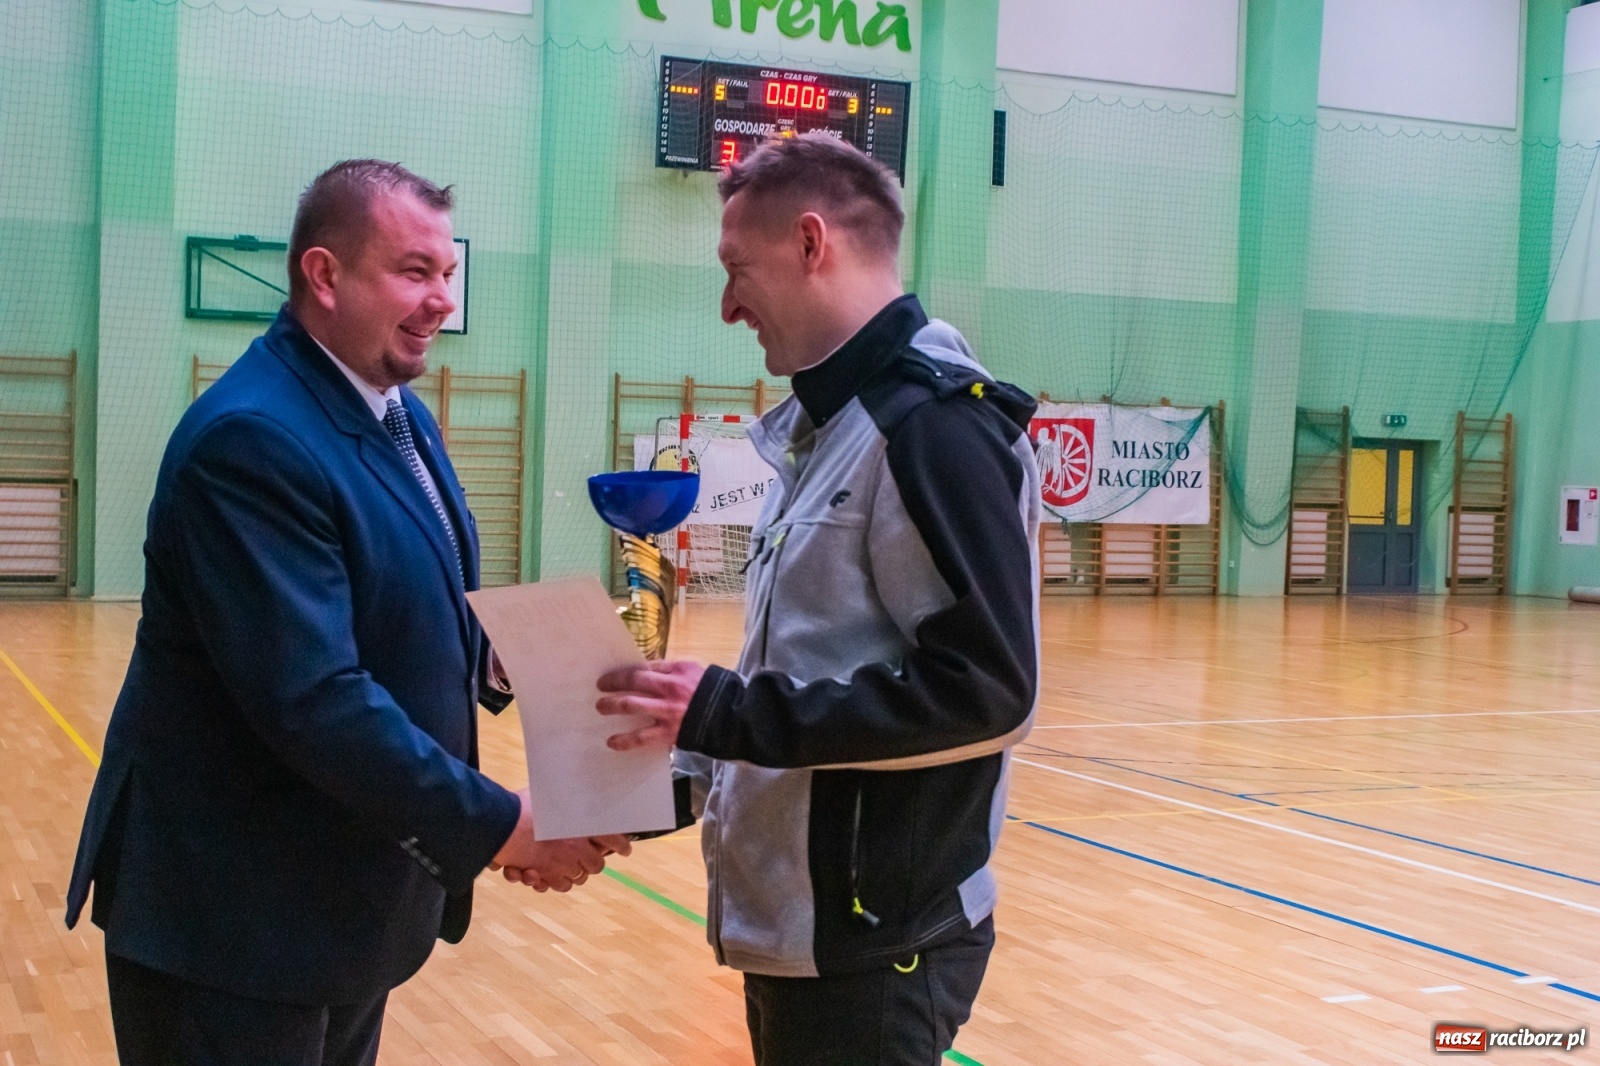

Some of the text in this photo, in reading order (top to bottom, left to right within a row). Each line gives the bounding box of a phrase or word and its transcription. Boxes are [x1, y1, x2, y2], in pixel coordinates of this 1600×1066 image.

[760, 70, 779, 79] CZAS
[784, 72, 802, 81] CZAS
[803, 74, 818, 83] GRY
[715, 84, 725, 100] 5
[848, 98, 858, 114] 3
[714, 118, 776, 135] GOSPODARZE
[722, 141, 735, 163] 3
[1111, 440, 1190, 461] MIASTO
[1098, 468, 1203, 489] RACIBORZ
[710, 487, 745, 509] JEST
[749, 482, 764, 497] W
